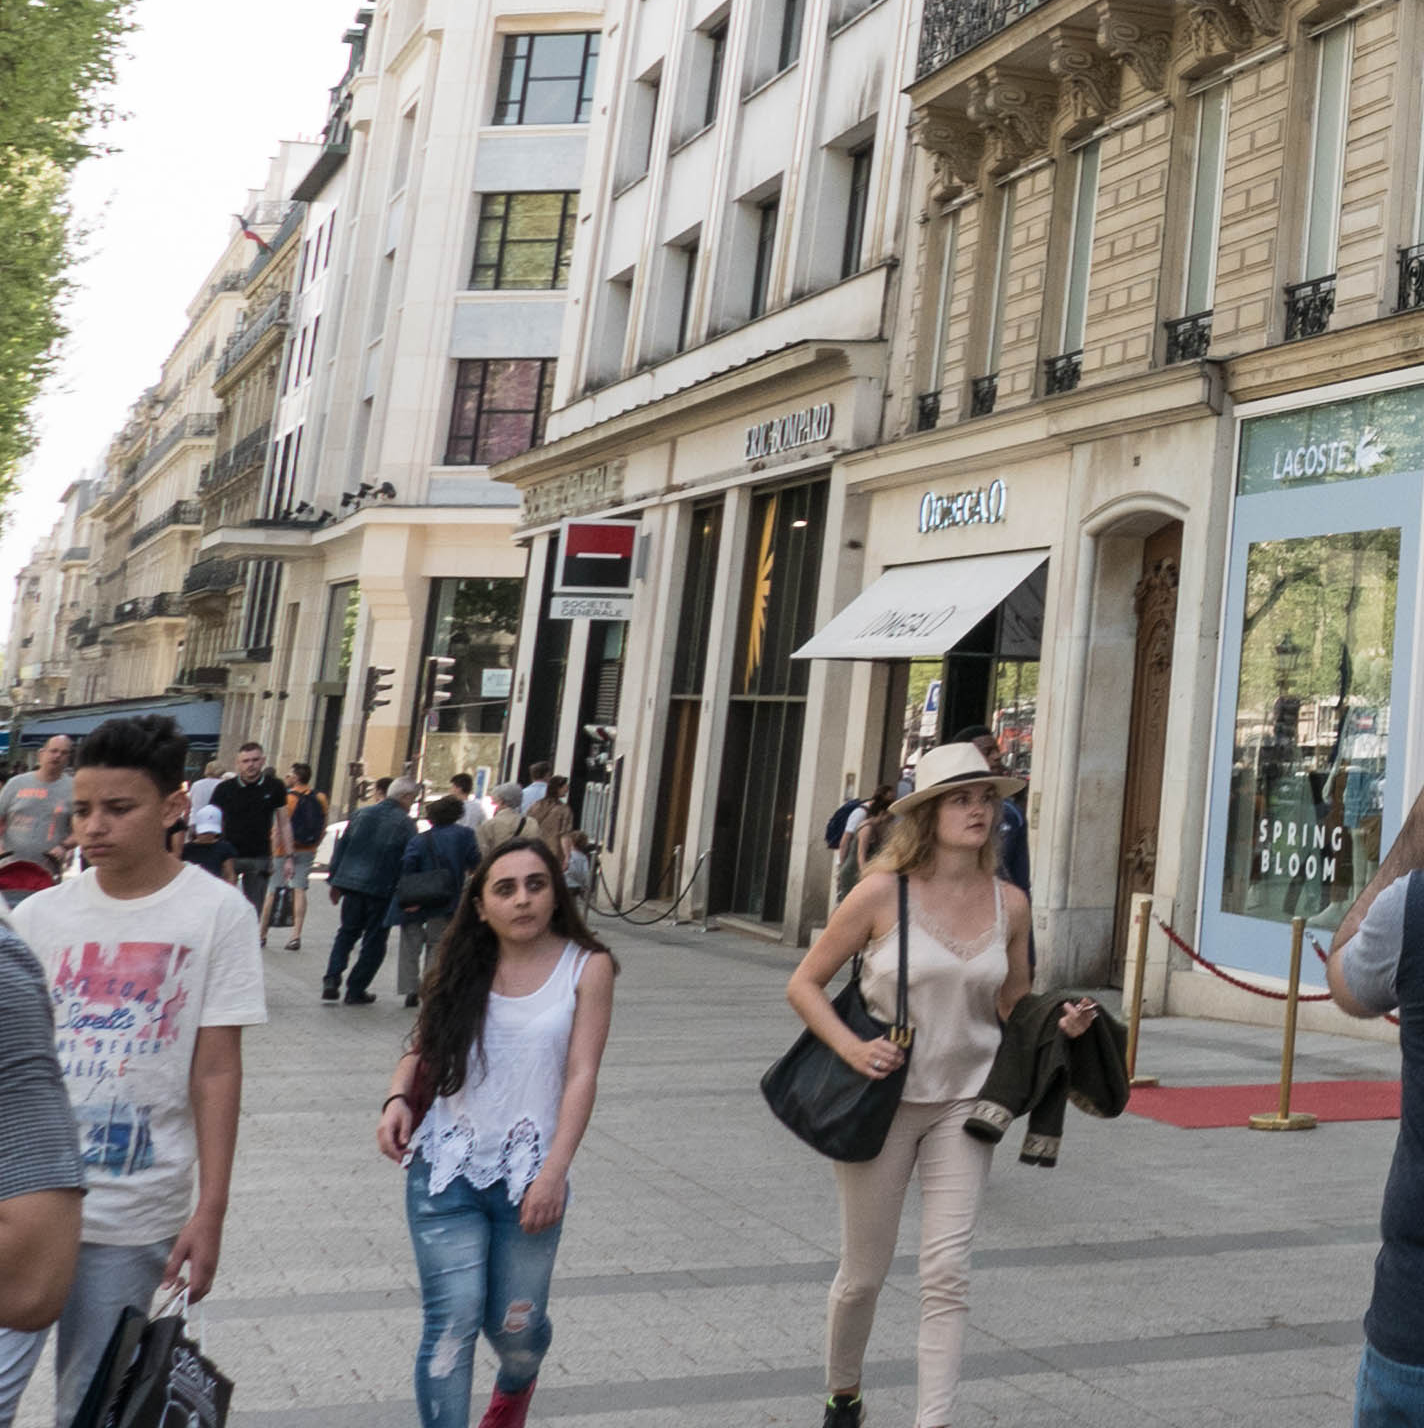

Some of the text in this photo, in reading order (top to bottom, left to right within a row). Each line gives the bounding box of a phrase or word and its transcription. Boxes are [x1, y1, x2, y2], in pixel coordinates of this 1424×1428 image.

[744, 402, 834, 462] ERIC BOMPARD
[1272, 440, 1349, 481] LACOSTE
[1259, 818, 1343, 852] SPRING
[1261, 849, 1337, 883] BLOOM
